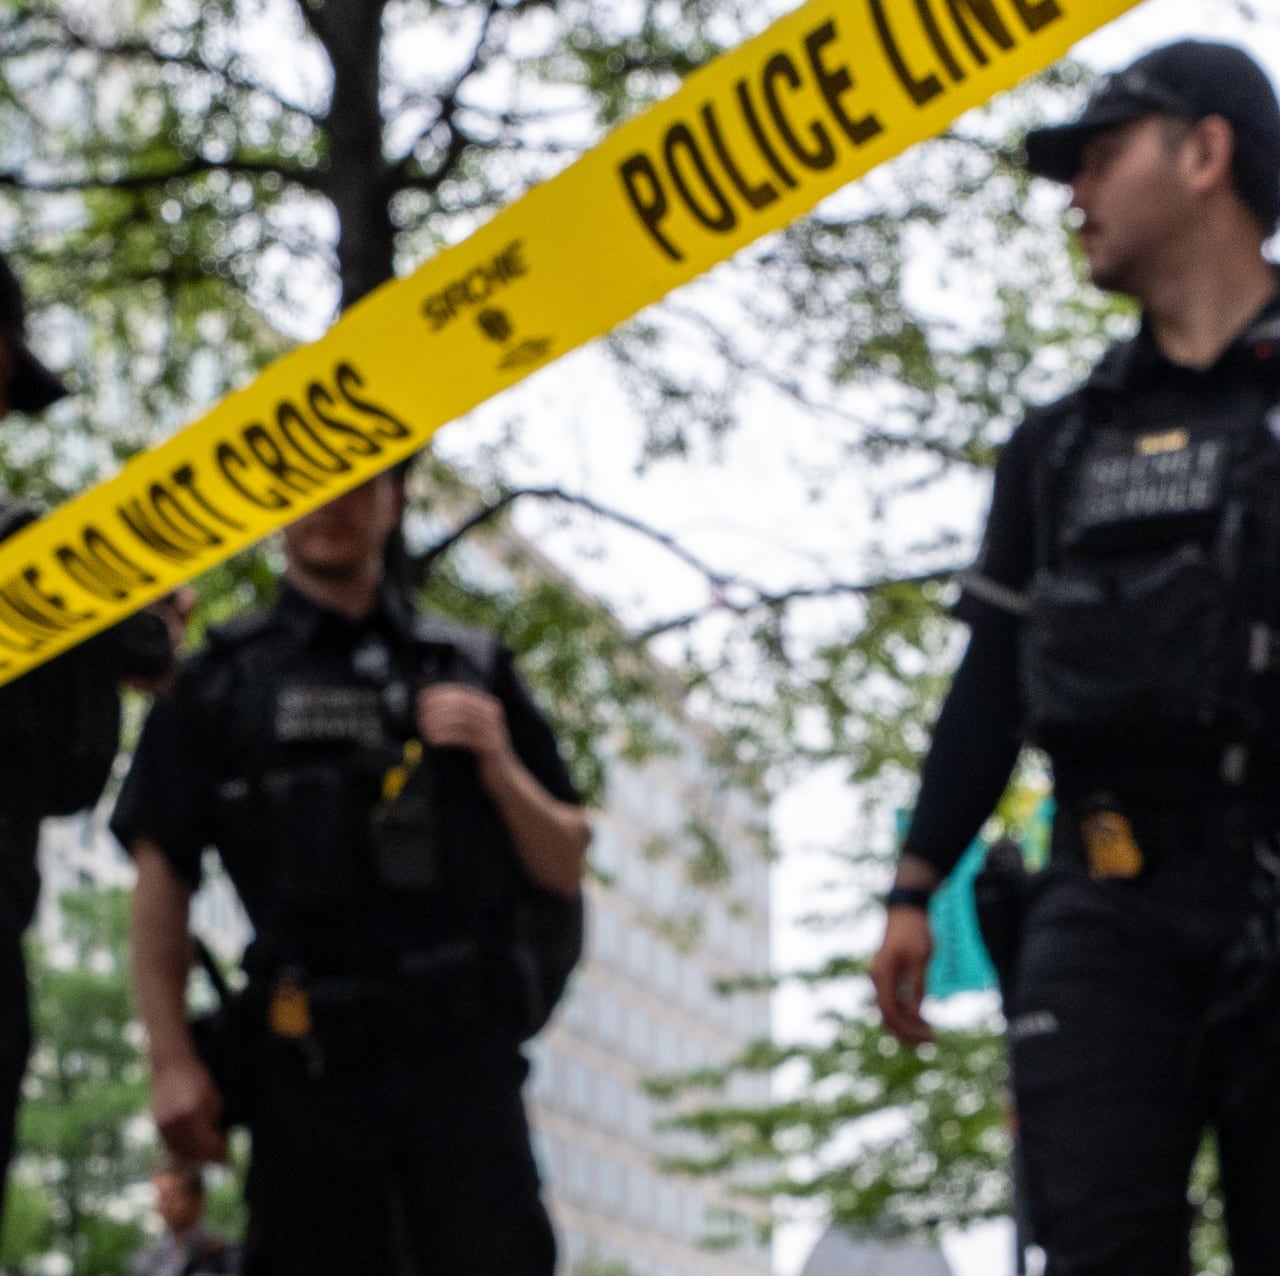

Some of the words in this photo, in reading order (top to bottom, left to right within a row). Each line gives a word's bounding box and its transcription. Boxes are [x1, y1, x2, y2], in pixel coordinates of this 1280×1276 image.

[617, 19, 884, 262] POLICE
[866, 0, 1063, 107] LIN
[54, 526, 156, 600] DO
[118, 463, 244, 560] NOT
[215, 361, 411, 509] CROSS
